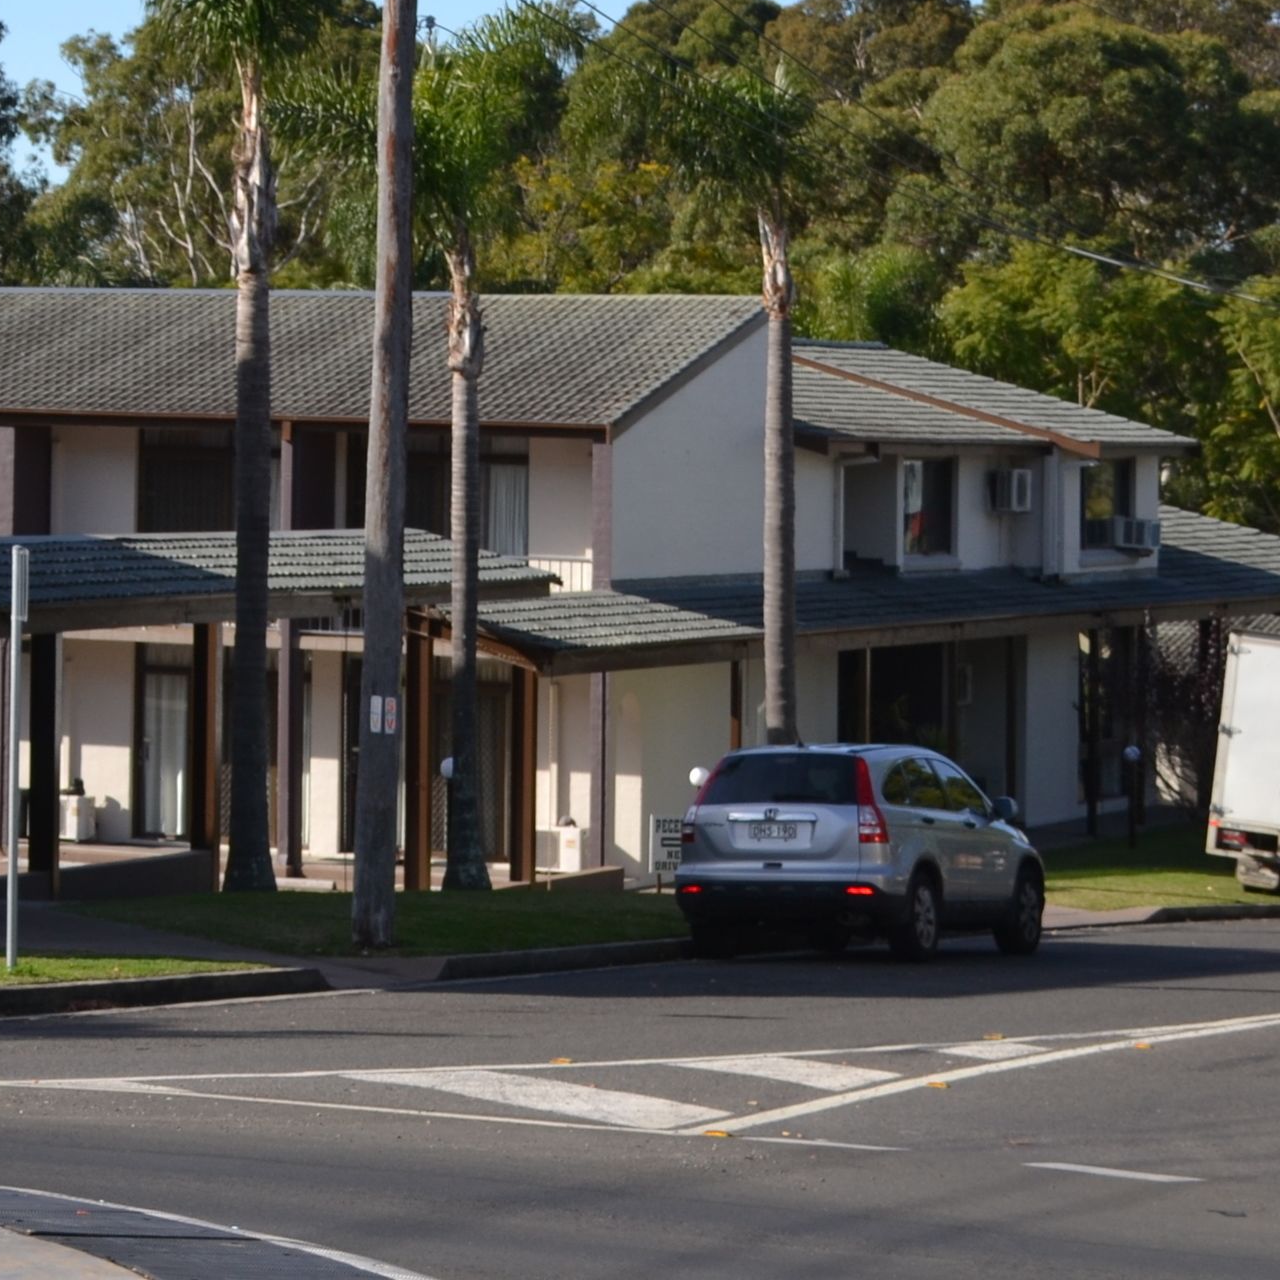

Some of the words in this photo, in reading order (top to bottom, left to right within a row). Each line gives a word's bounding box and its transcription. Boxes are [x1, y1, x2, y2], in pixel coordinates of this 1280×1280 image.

[655, 819, 682, 833] RECE
[666, 850, 681, 860] NE
[655, 861, 679, 871] DRIV
